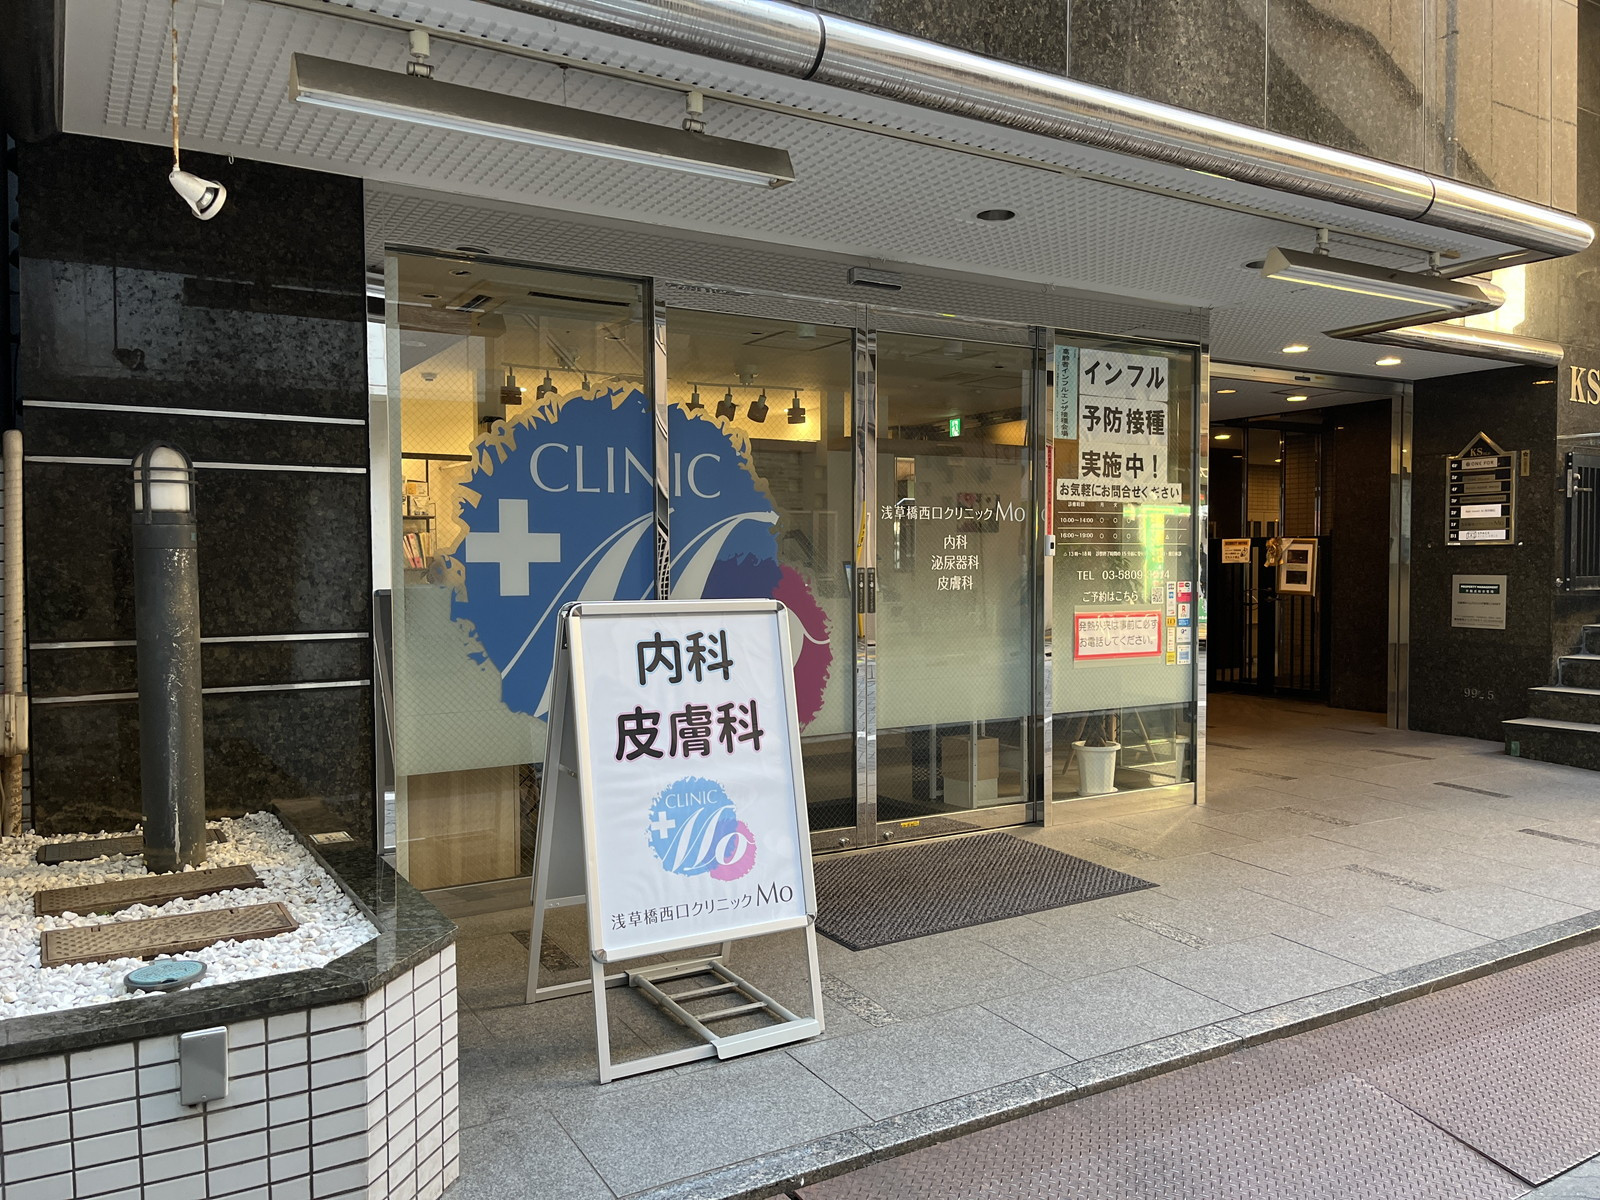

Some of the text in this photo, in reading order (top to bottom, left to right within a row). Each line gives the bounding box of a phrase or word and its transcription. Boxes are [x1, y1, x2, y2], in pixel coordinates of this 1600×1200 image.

[1084, 360, 1165, 390] インフル
[1569, 365, 1600, 405] KS
[1082, 405, 1165, 436] 予防接種
[1470, 447, 1483, 457] KS
[529, 441, 721, 499] CLINIC
[1059, 483, 1180, 500] お気軽にお問合せください
[943, 534, 968, 550] 内科
[931, 555, 980, 571] 泌尿器科
[936, 575, 973, 591] 皮膚科
[1076, 570, 1095, 581] TEL
[1082, 590, 1139, 603] ご予約はこちら
[635, 629, 734, 686] 内科
[614, 698, 764, 763] 皮膚科
[664, 789, 718, 809] CLINIC
[662, 804, 756, 873] Mo
